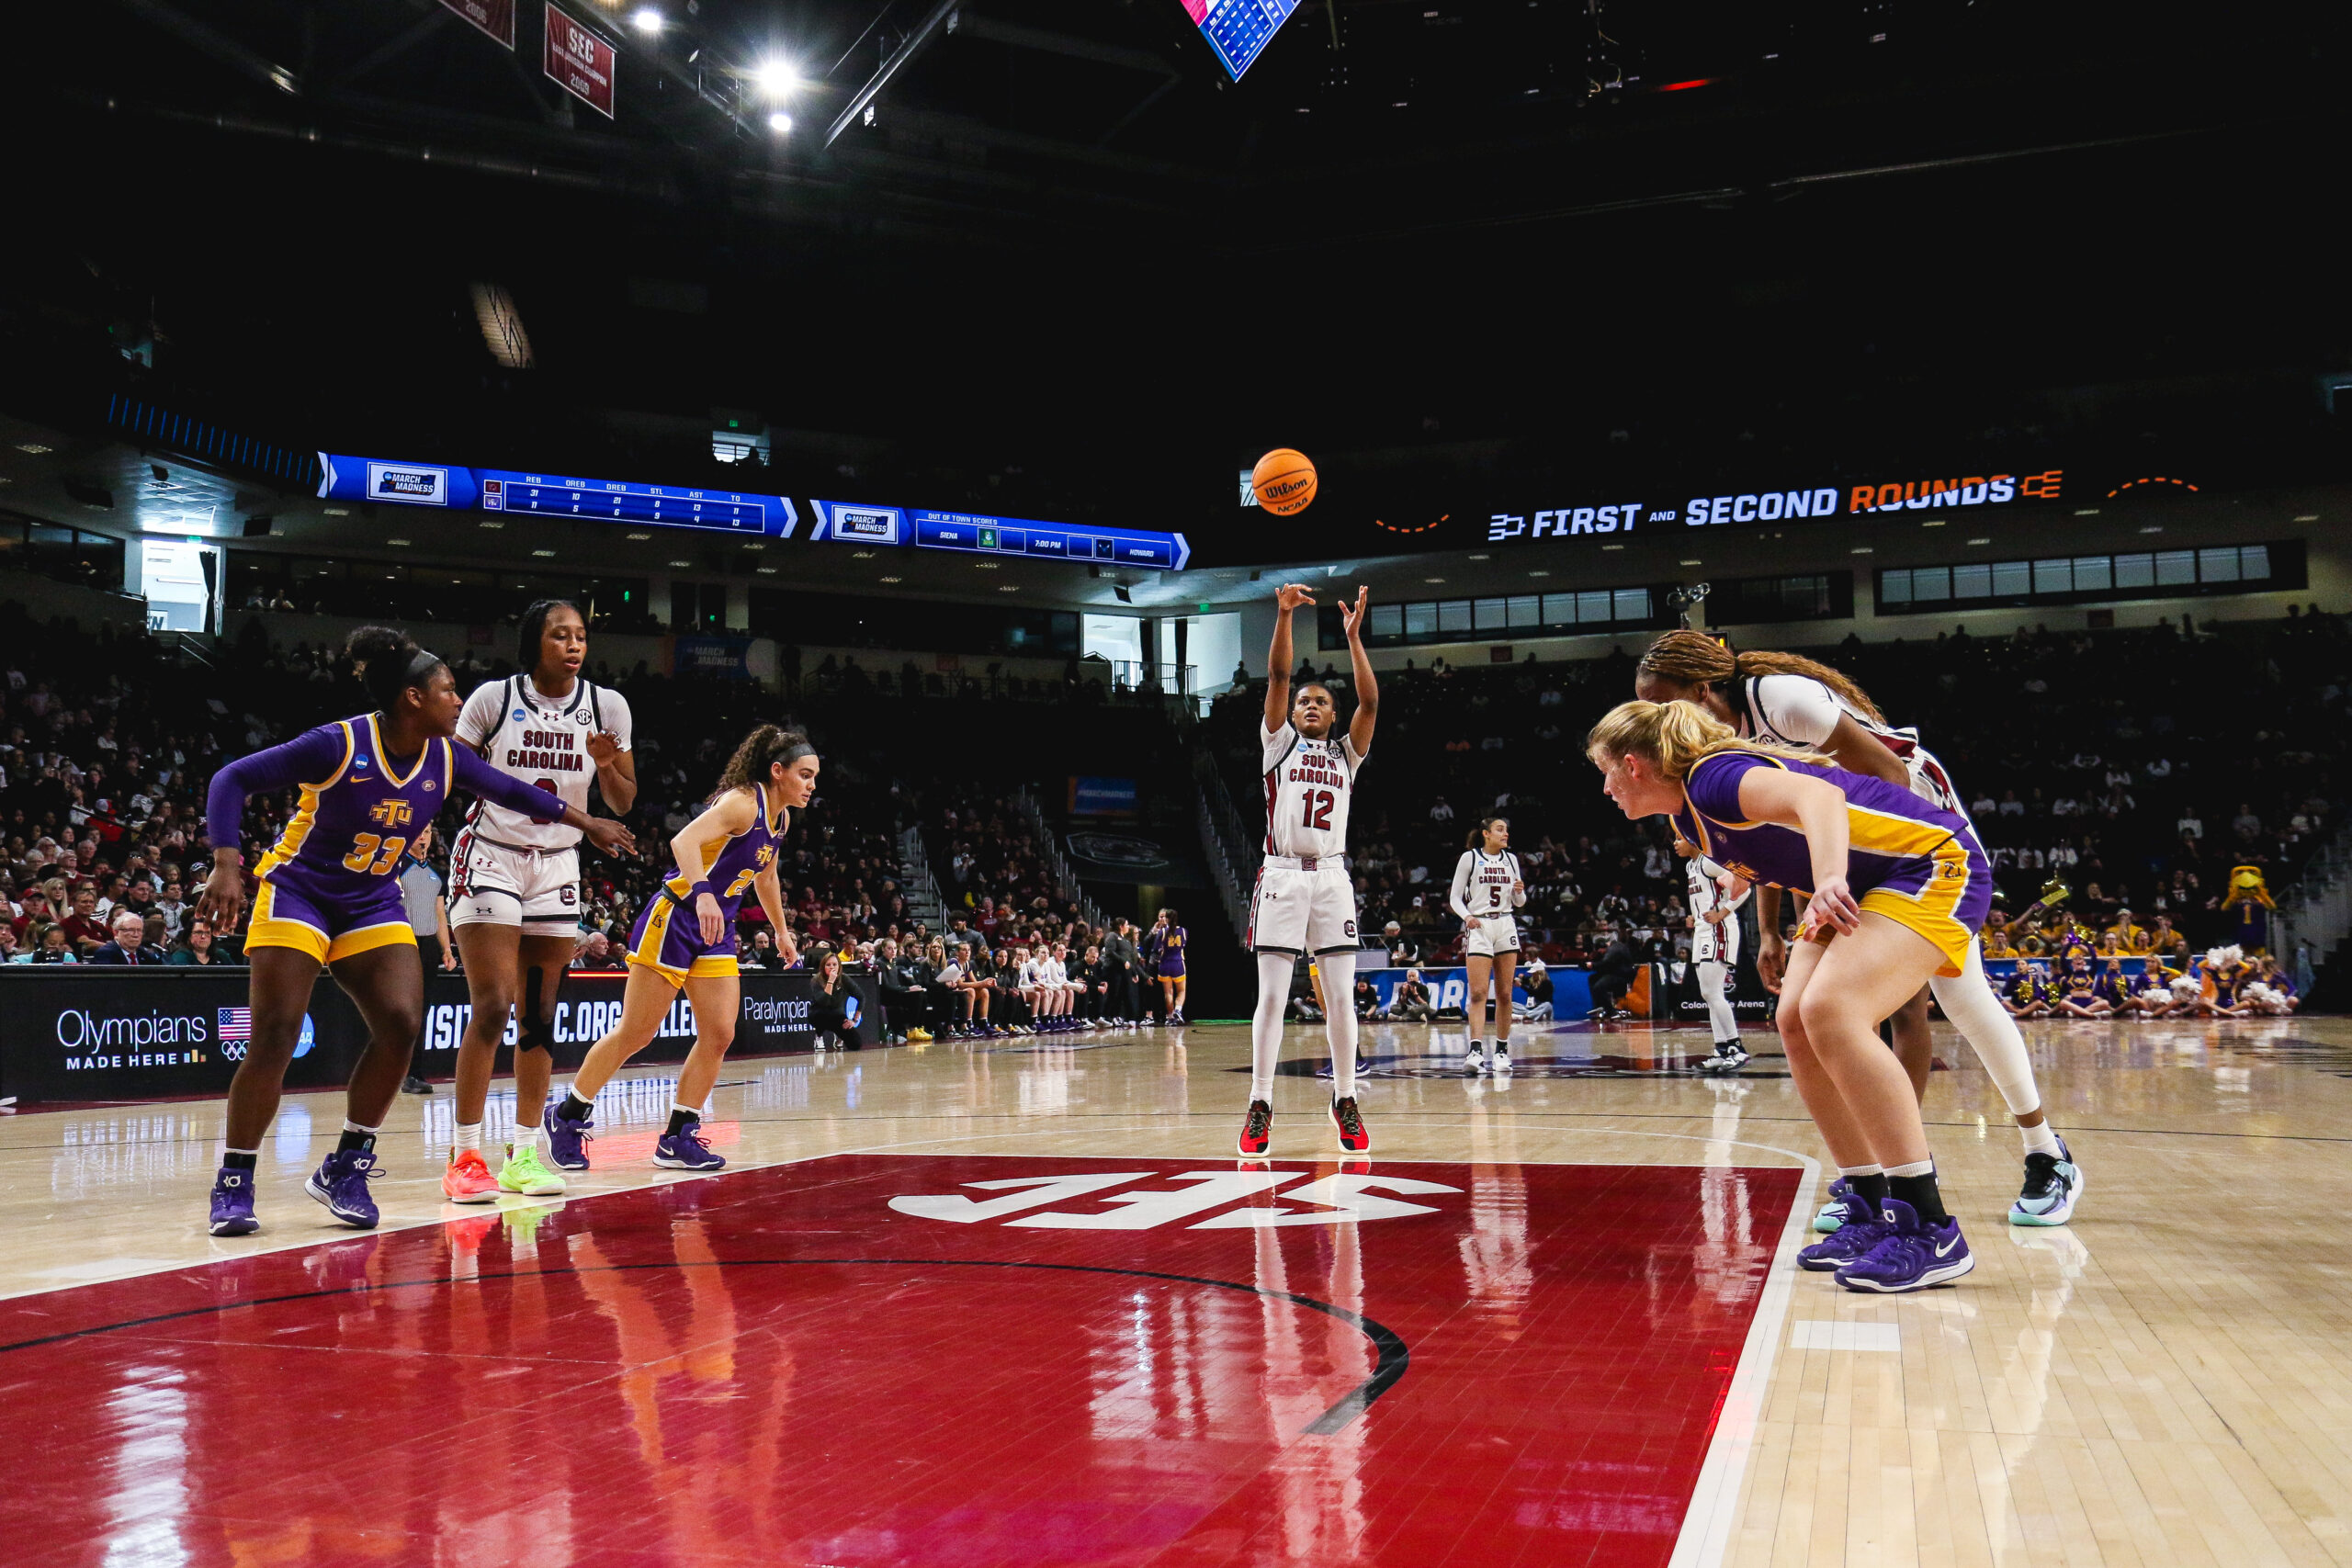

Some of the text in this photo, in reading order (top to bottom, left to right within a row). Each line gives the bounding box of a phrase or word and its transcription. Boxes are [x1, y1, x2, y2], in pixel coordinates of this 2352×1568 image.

[569, 27, 594, 64] SEC
[392, 473, 421, 484] MARCH
[526, 476, 541, 484] REB
[650, 487, 663, 495] STL
[395, 483, 434, 493] MADNESS
[530, 489, 538, 497] 31
[572, 492, 580, 501] 10
[1264, 479, 1307, 499] Wilson
[1532, 474, 2015, 537] FIRST AND SECOND ROUNDS
[852, 515, 876, 525] MARCH
[952, 514, 970, 524] TOWN
[972, 516, 998, 525] SCORES
[854, 524, 887, 533] MADNESS
[940, 531, 957, 539] SIENA
[1050, 541, 1061, 549] PM
[1129, 548, 1154, 558] HOWARD
[695, 647, 725, 656] MARCH
[577, 712, 591, 725] SEC
[523, 730, 574, 750] SOUTH
[507, 750, 582, 772] CAROLINA
[1302, 754, 1338, 771] SOUH
[1290, 769, 1343, 790] CAROLINA
[369, 798, 413, 829] TTU
[1303, 788, 1335, 831] 12
[342, 831, 407, 876] 33
[1479, 875, 1510, 884] CAROLINA
[1489, 886, 1501, 908] 5
[57, 1008, 206, 1055] Olympians
[764, 1023, 808, 1033] MADE HERE
[66, 1053, 177, 1070] MADE HERE
